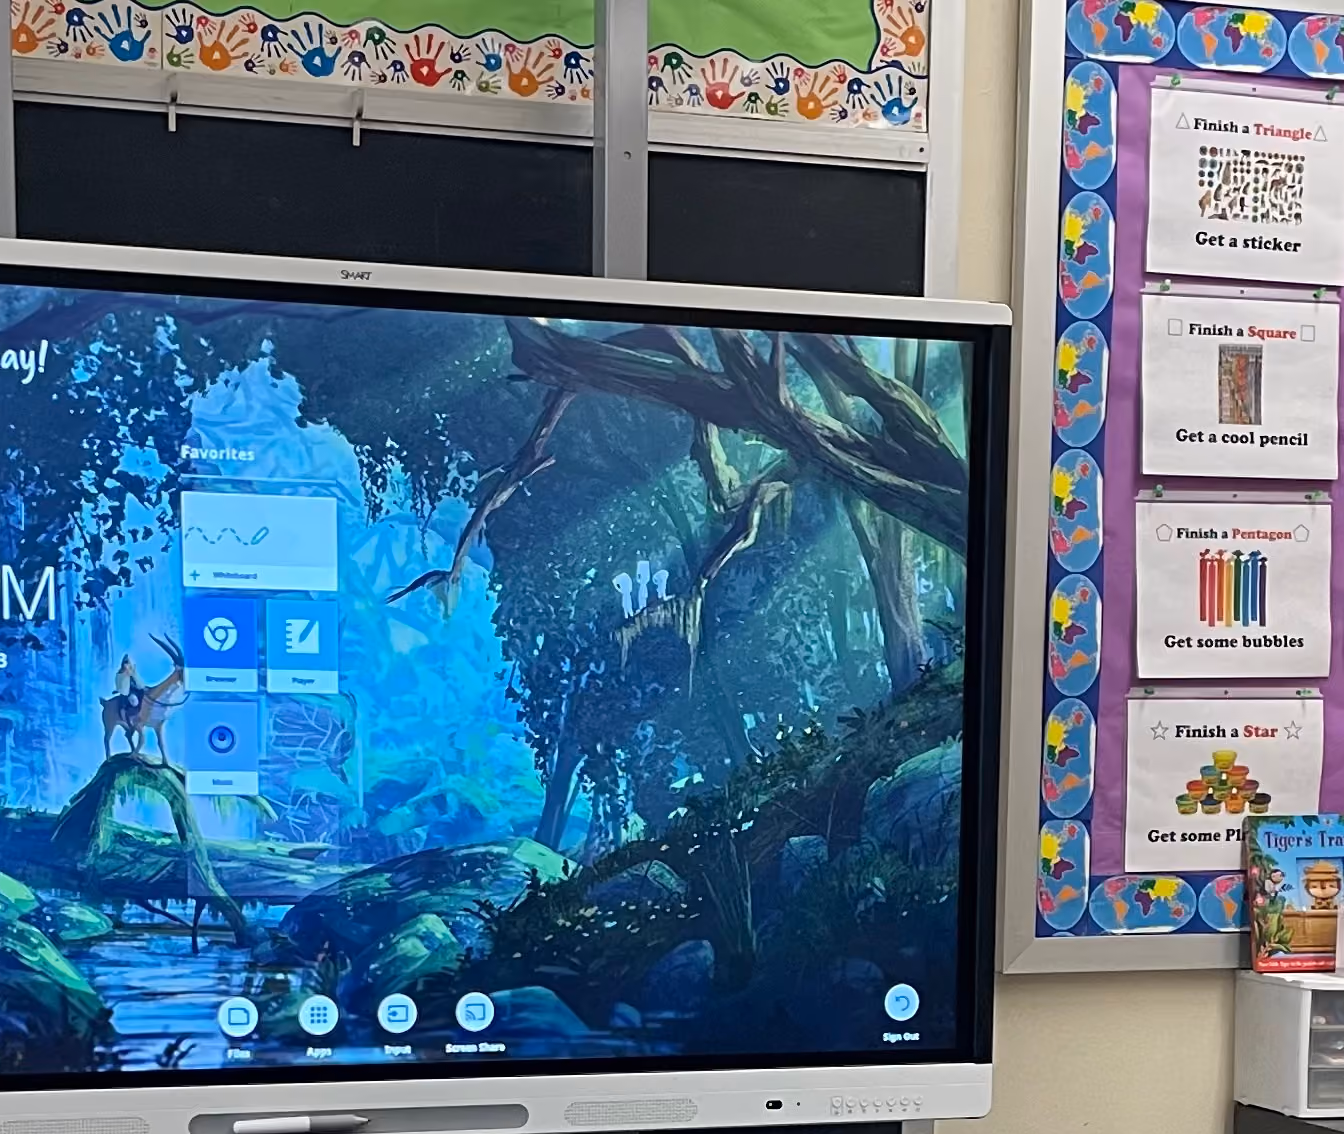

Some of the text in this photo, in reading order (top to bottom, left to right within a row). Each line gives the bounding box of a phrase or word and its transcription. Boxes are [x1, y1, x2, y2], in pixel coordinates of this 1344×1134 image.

[1193, 117, 1312, 142] Finish a Triangle
[1195, 231, 1301, 253] Get a sticker
[340, 269, 372, 281] SMART
[1188, 323, 1297, 340] Finish a Square
[1175, 428, 1308, 447] Get a cool pencil
[181, 445, 255, 462] Favorites
[1176, 527, 1292, 542] Finish a Pentagon
[1164, 635, 1305, 648] Get some bubbles
[1175, 724, 1278, 739] Finish a Star
[1147, 828, 1176, 843] Get
[1180, 832, 1221, 843] some
[1264, 830, 1313, 853] Tiger's
